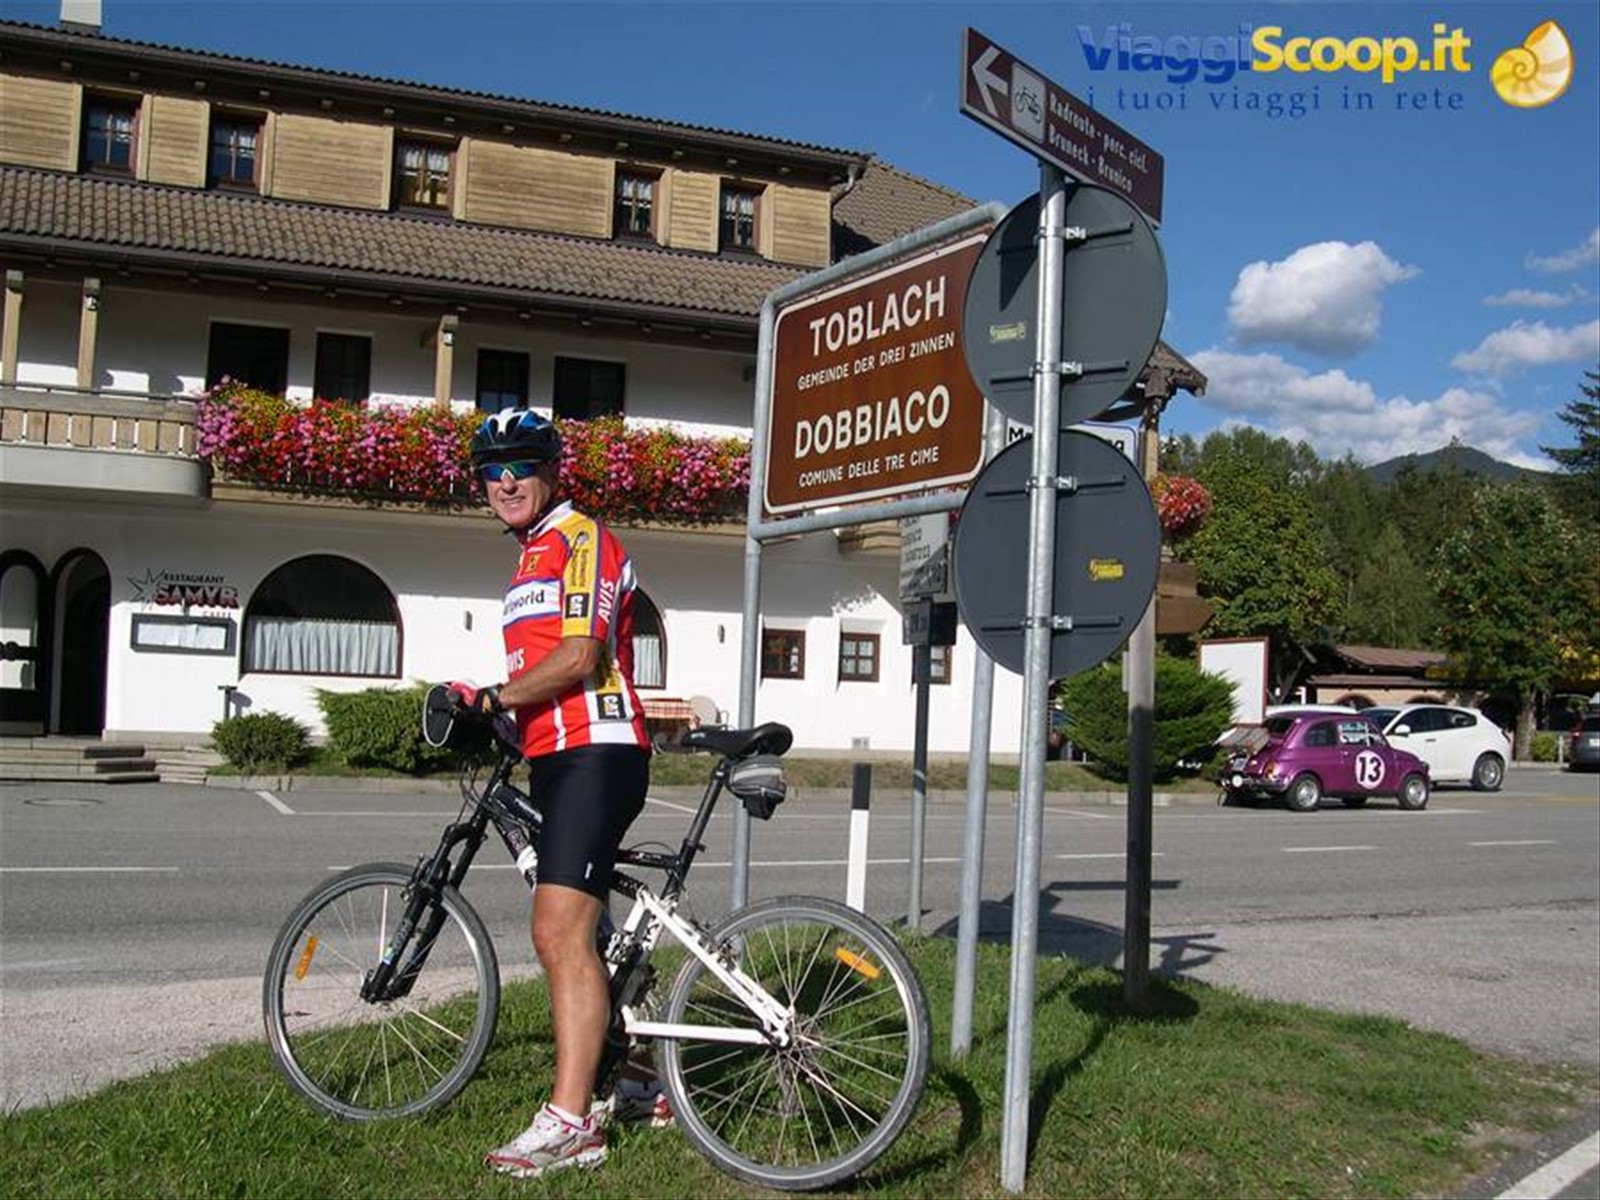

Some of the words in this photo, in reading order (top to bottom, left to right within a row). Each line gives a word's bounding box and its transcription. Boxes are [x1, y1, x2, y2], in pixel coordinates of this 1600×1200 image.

[809, 275, 946, 356] TOBLACH
[797, 363, 850, 391] GEMEINDE
[854, 356, 876, 376] DER
[880, 346, 906, 366] DREI
[909, 331, 955, 360] ZINNEN
[795, 384, 951, 460] DOBBIACO
[799, 467, 845, 488] COMUNE
[848, 460, 880, 481] DELLE
[884, 453, 906, 472] TRE
[910, 445, 940, 467] CIME
[598, 578, 615, 625] AVIS
[1359, 756, 1381, 782] 13
